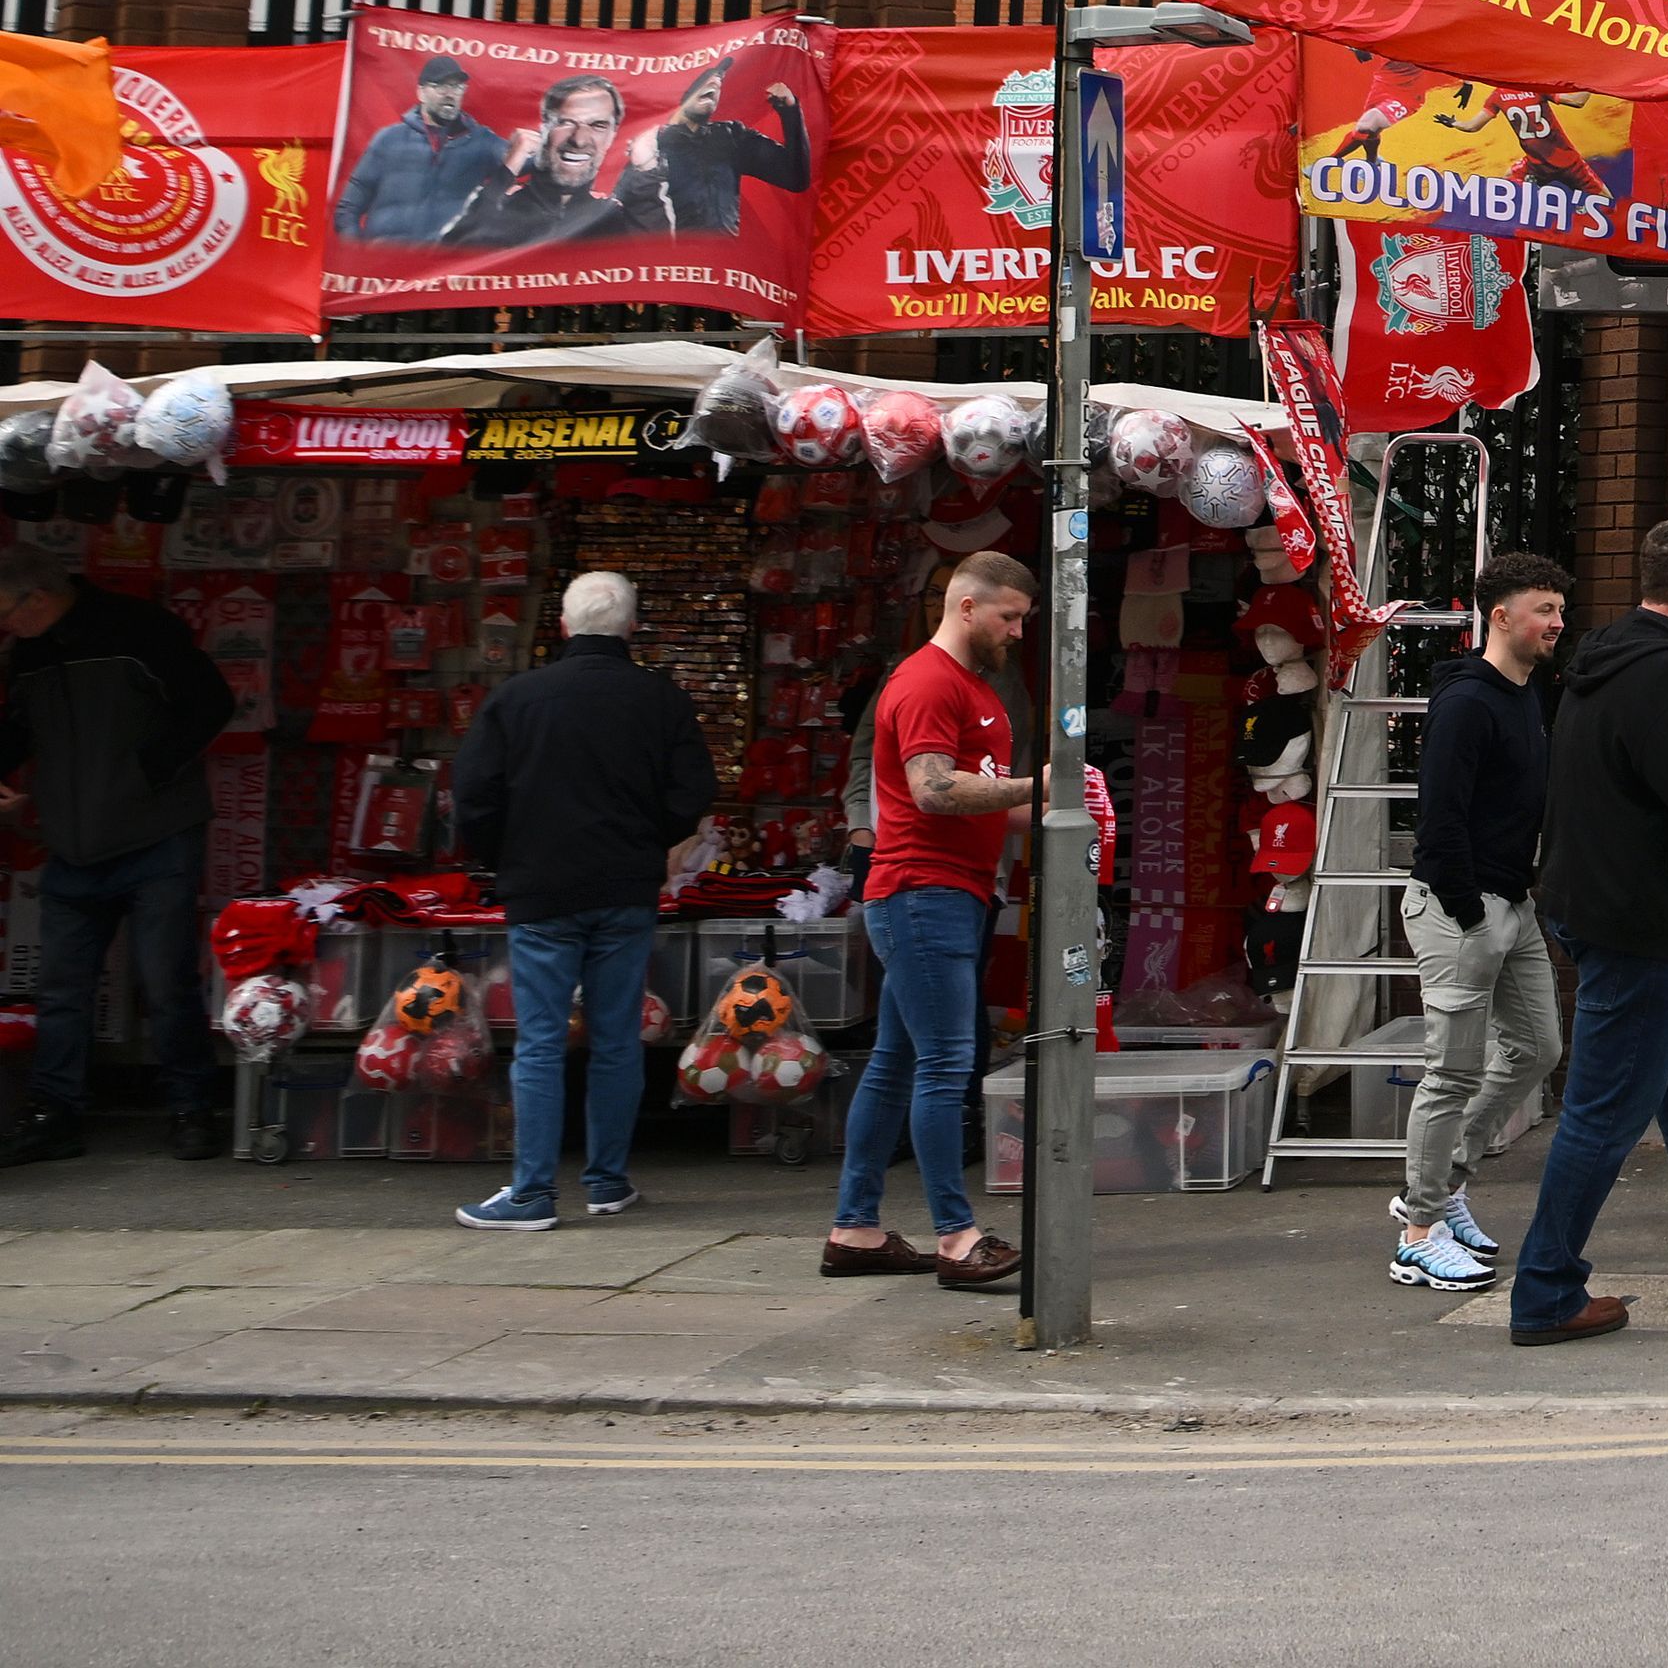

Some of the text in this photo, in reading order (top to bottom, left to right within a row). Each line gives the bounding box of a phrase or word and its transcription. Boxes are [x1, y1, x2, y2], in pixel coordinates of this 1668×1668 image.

[416, 34, 487, 59] SOOO
[487, 42, 561, 66] GLAD
[564, 51, 630, 71] THAT
[631, 44, 724, 77] JURGEN
[744, 30, 768, 48] A
[1121, 45, 1169, 81] EVER
[1386, 100, 1409, 124] 23
[1506, 104, 1551, 140] 23
[1150, 94, 1256, 183] FOOTBALL
[815, 112, 934, 236] ERPOOL
[895, 143, 944, 192] CLUB
[1309, 156, 1615, 239] COLOMBIA'S
[260, 215, 310, 248] LFC
[445, 273, 512, 294] WITH
[516, 271, 573, 289] HIM
[574, 267, 636, 286] AND
[637, 265, 652, 283] I
[653, 264, 720, 286] FEEL
[1160, 245, 1219, 281] FC
[1446, 249, 1463, 316] LIVERPOOL
[887, 293, 968, 318] You'll
[975, 292, 1052, 315] Neve
[1142, 289, 1217, 313] Alone
[1440, 293, 1448, 314] CLUB
[1270, 335, 1314, 438] LEAGUE
[295, 415, 637, 449] LIVERPOOL ARSENAL
[368, 449, 432, 461] SUNDAY
[466, 449, 508, 461] APRIL
[513, 449, 556, 460] 2023
[319, 701, 383, 716] ANFIELD
[236, 761, 265, 893] WALK ALON
[1103, 819, 1117, 845] THE
[1137, 776, 1164, 875] ALONE
[1164, 784, 1186, 876] NEVER
[1188, 836, 1207, 905] ALONE
